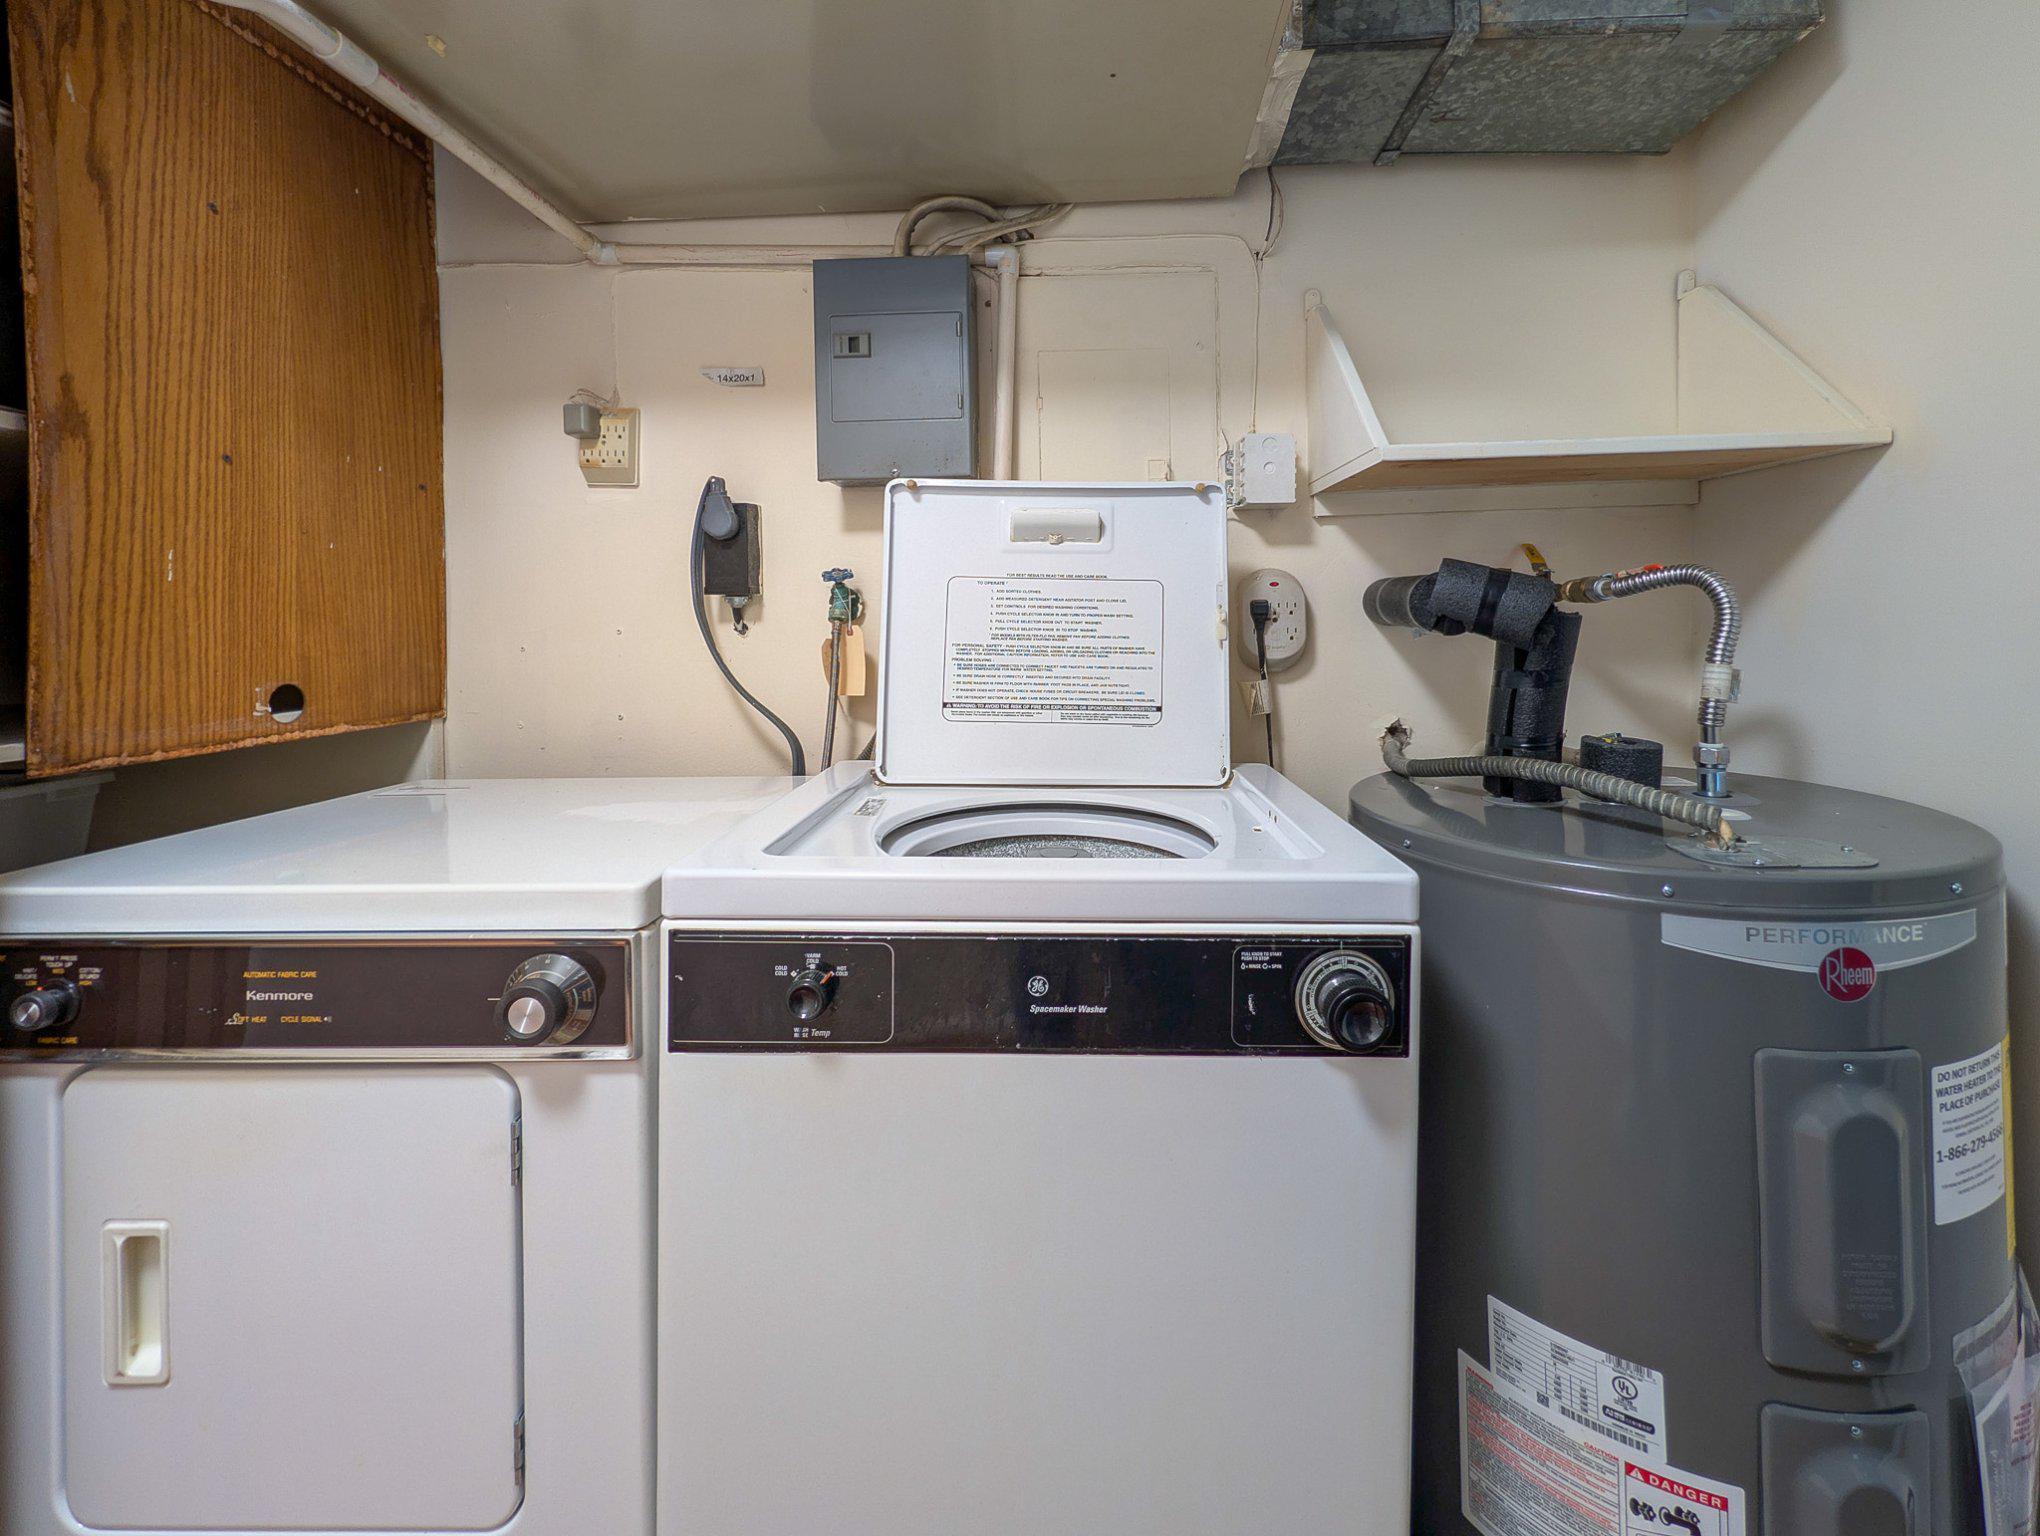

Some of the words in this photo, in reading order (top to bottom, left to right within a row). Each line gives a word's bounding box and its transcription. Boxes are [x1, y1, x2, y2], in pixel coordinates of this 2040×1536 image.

[718, 374, 754, 383] 14x20x1
[1746, 925, 1924, 945] PERFORMANCE
[1825, 947, 1873, 992] Rheem
[246, 990, 313, 1000] Kenmore
[1030, 1004, 1077, 1014] Spacemaker
[1078, 1005, 1107, 1013] Washer
[812, 1028, 830, 1038] Temp
[1938, 1071, 1950, 1082] DO
[1952, 1066, 1968, 1079] NOT
[1968, 1058, 1990, 1074] RETURN
[1936, 1083, 1963, 1098] WATER
[1964, 1074, 1986, 1091] HEATER
[1939, 1098, 1964, 1113] PLACE
[1965, 1095, 1974, 1106] OF
[1584, 1442, 1619, 1462] CAUTION
[1650, 1474, 1722, 1508] DANGER
